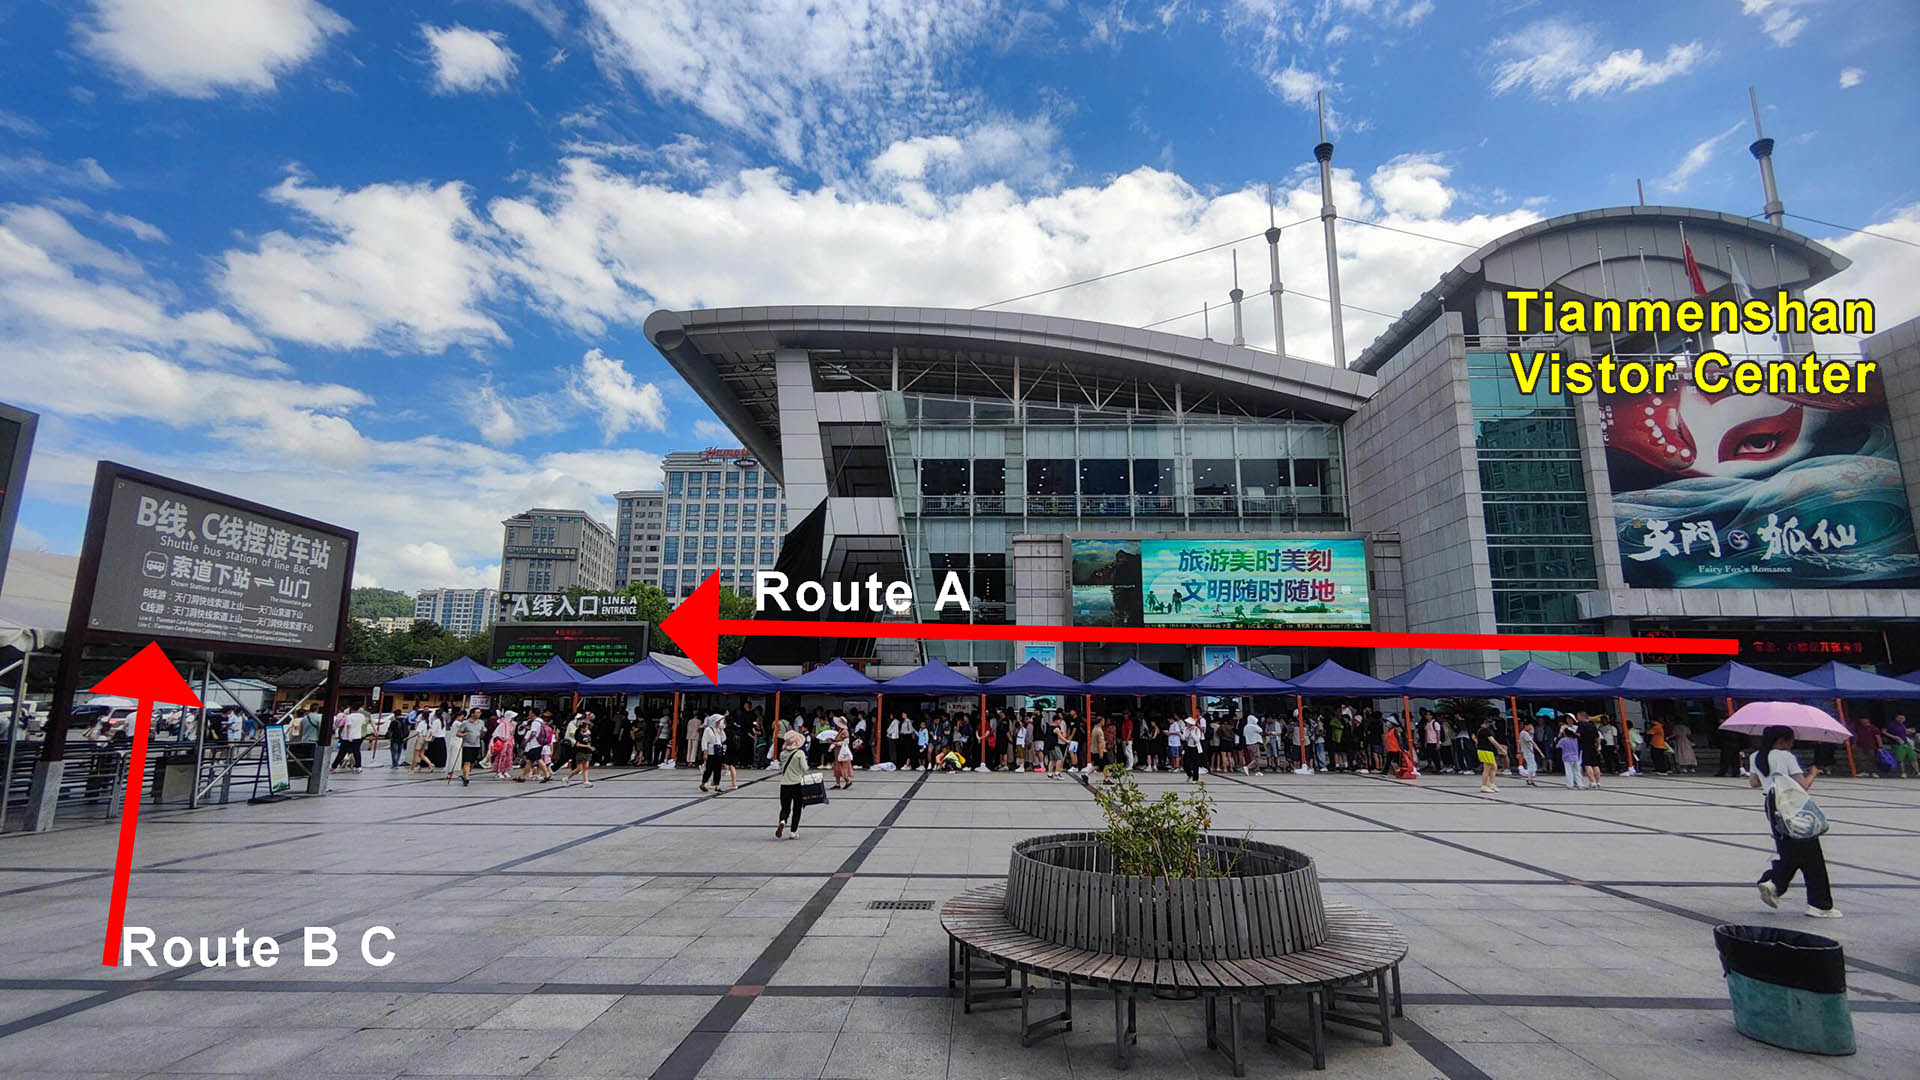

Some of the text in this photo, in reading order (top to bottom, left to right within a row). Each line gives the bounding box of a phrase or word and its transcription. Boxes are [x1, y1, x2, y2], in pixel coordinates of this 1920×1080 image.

[136, 496, 332, 570] B线、C线摆渡车站
[160, 536, 311, 576] Shuttle bus station of line B&C
[1177, 548, 1332, 573] 旅游美时美刻
[170, 555, 311, 600] 索道下站 山门
[1698, 564, 1793, 575] Fairy Fox's Romance
[602, 595, 638, 605] LINE A
[1181, 577, 1335, 603] 文明随时随地
[511, 594, 599, 617] A线入口
[601, 606, 637, 615] ENTRANCE
